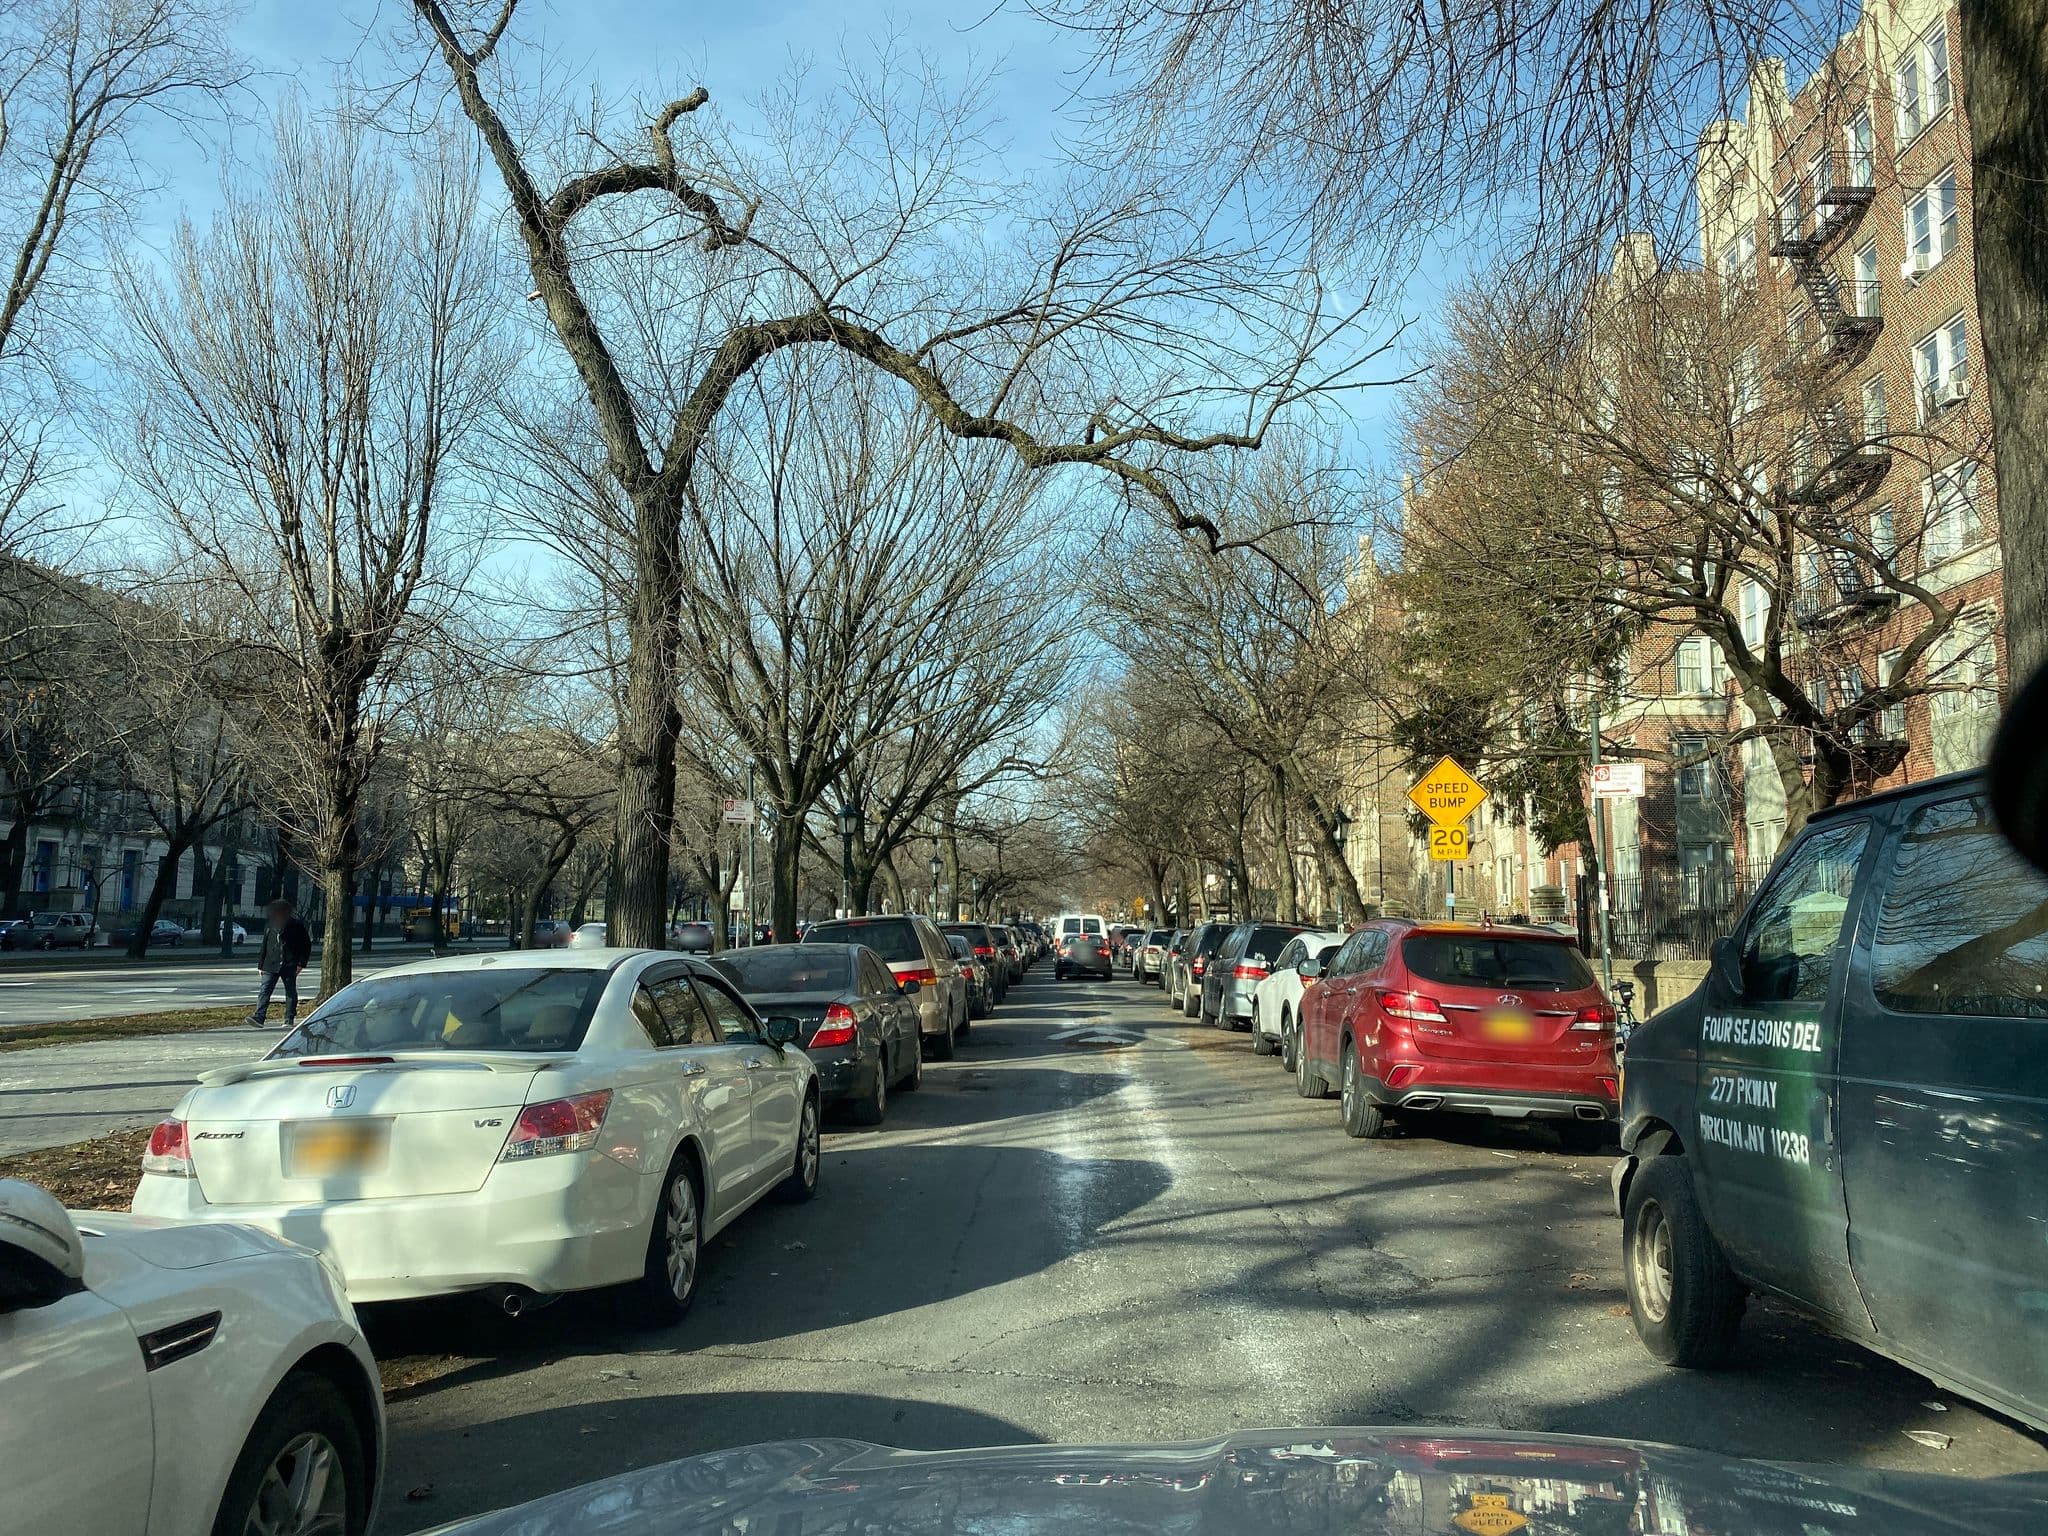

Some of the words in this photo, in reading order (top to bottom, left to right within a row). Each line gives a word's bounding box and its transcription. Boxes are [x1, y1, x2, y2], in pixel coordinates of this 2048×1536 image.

[1427, 783, 1469, 793] SPEED
[1430, 798, 1466, 808] BUMP
[1434, 830, 1464, 846] 20
[1702, 1016, 1733, 1043] FOUR
[1734, 1018, 1792, 1048] SEASONS
[1710, 1076, 1734, 1103] 277
[1737, 1077, 1777, 1109] PKWAY
[474, 1118, 504, 1128] V6
[194, 1130, 246, 1140] Accord
[1770, 1128, 1810, 1164] 11238
